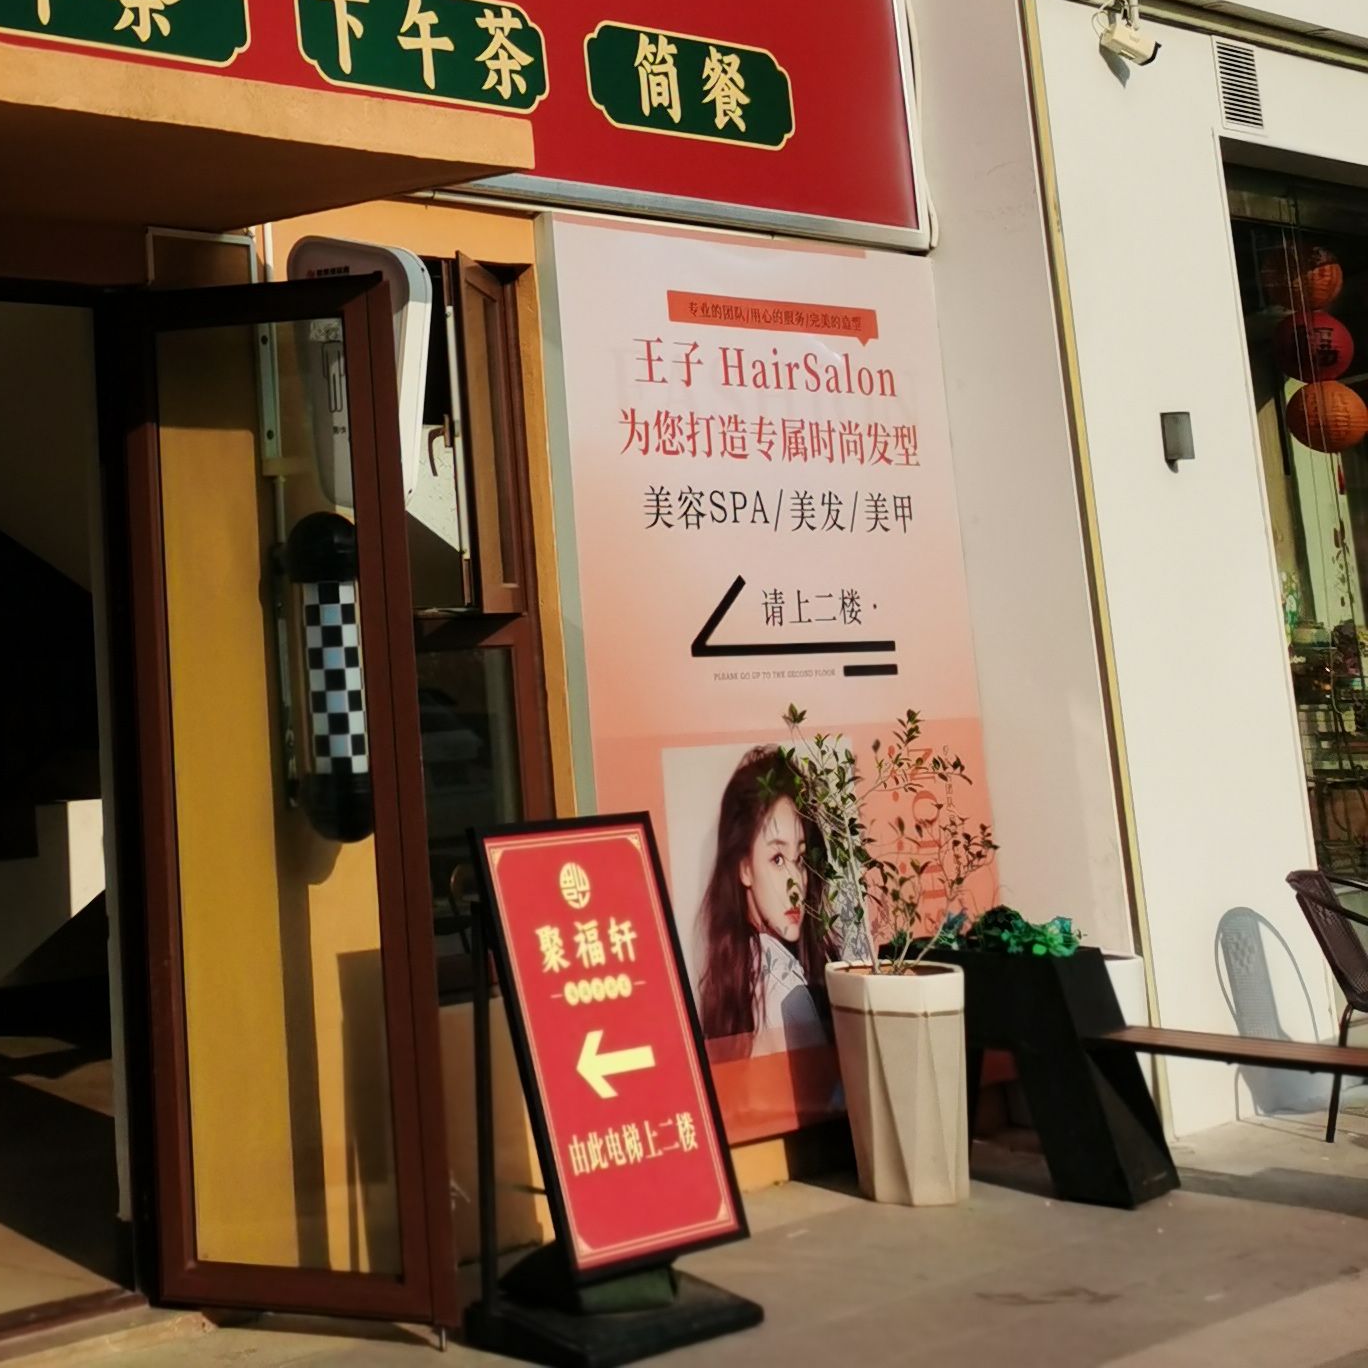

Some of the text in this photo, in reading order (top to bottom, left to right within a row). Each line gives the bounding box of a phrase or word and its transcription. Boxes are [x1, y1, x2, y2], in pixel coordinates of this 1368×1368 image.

[632, 31, 750, 133] 简餐
[633, 336, 899, 398] 王子 HairSalon
[618, 407, 920, 467] 为您打造专属时尚发型
[644, 484, 913, 534] 美容SPA/美发/美甲
[761, 588, 862, 627] 请上二楼
[535, 916, 637, 973] 聚福轩
[568, 1112, 699, 1176] 由此电梯上二楼
